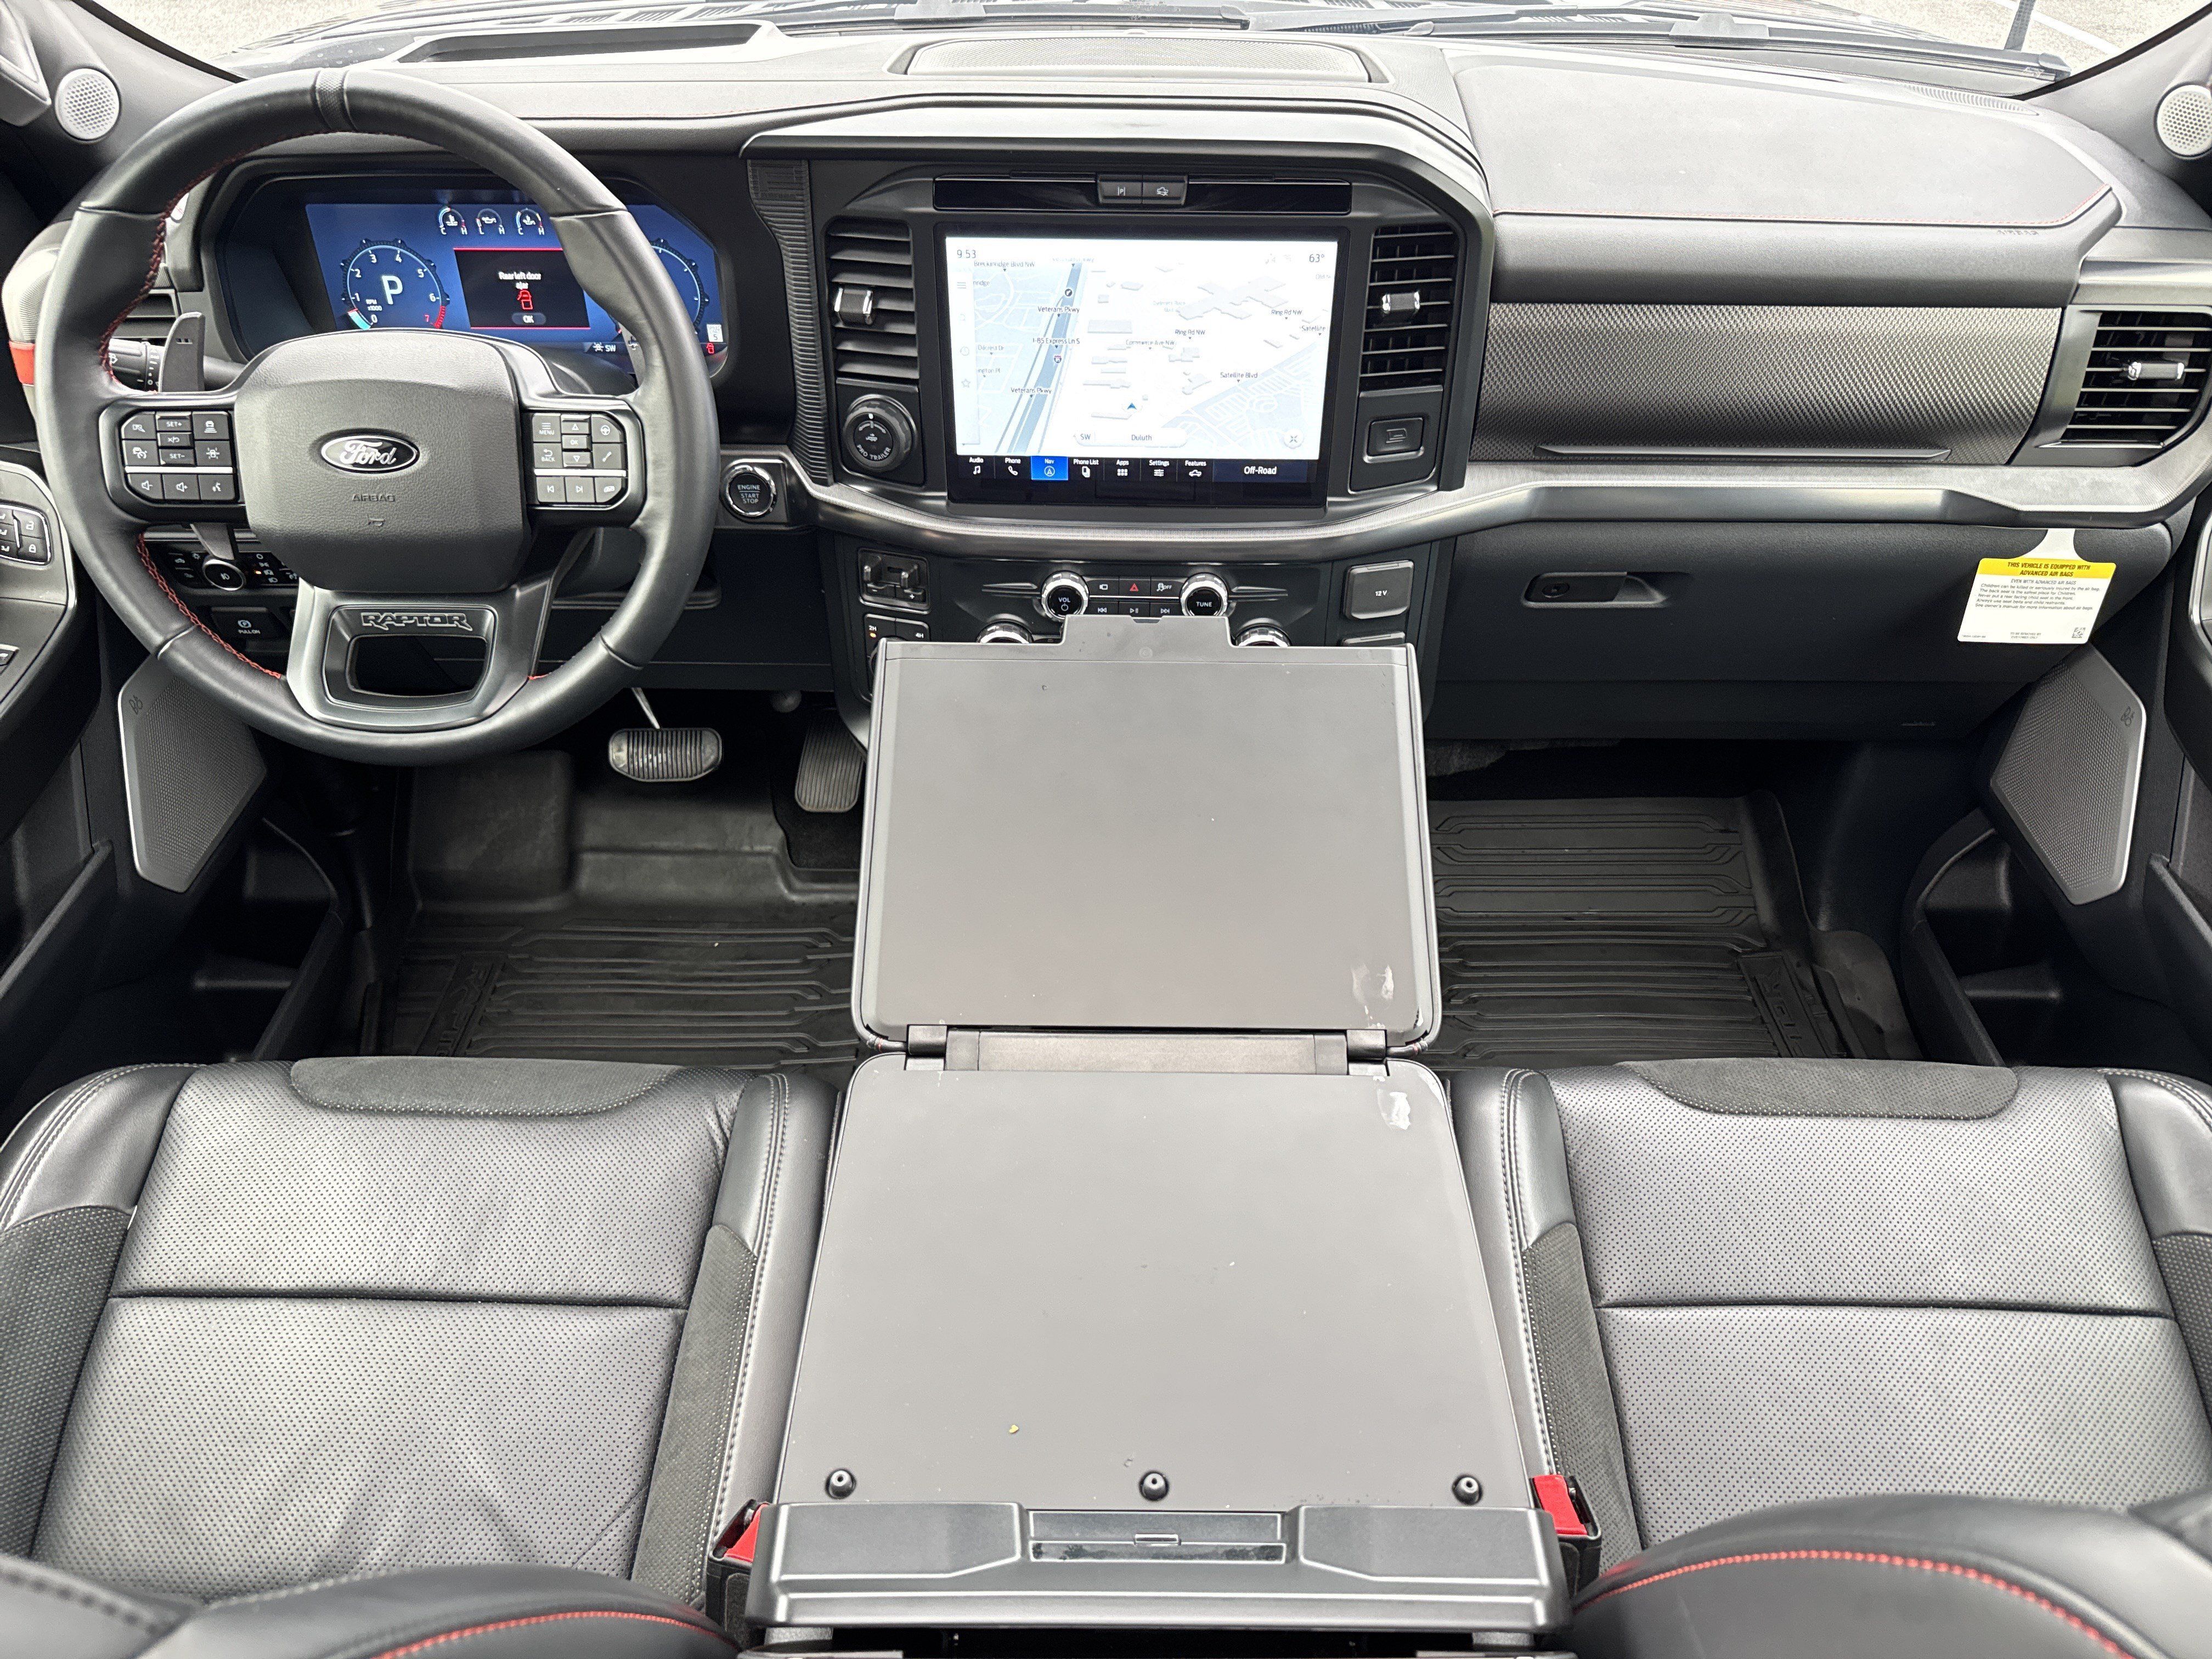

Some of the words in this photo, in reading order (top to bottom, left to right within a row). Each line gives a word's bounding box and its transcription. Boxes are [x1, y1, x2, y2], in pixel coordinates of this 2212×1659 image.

[957, 249, 976, 258] 953
[370, 254, 377, 263] 3
[396, 254, 402, 263] 4
[354, 269, 362, 278] 2
[417, 269, 424, 278] 5
[498, 271, 515, 280] Rear
[515, 272, 526, 280] left
[526, 271, 541, 280] door
[382, 275, 403, 304] P
[354, 293, 360, 301] 1
[429, 293, 436, 302] 6
[371, 314, 377, 323] 0
[523, 315, 534, 323] OK
[340, 440, 397, 465] Ford
[856, 444, 868, 457] PRO
[870, 447, 891, 460] TRAILER
[1244, 466, 1277, 475] Off-Road
[352, 494, 396, 502] AIRBAG
[360, 612, 472, 631] RAPTOR
